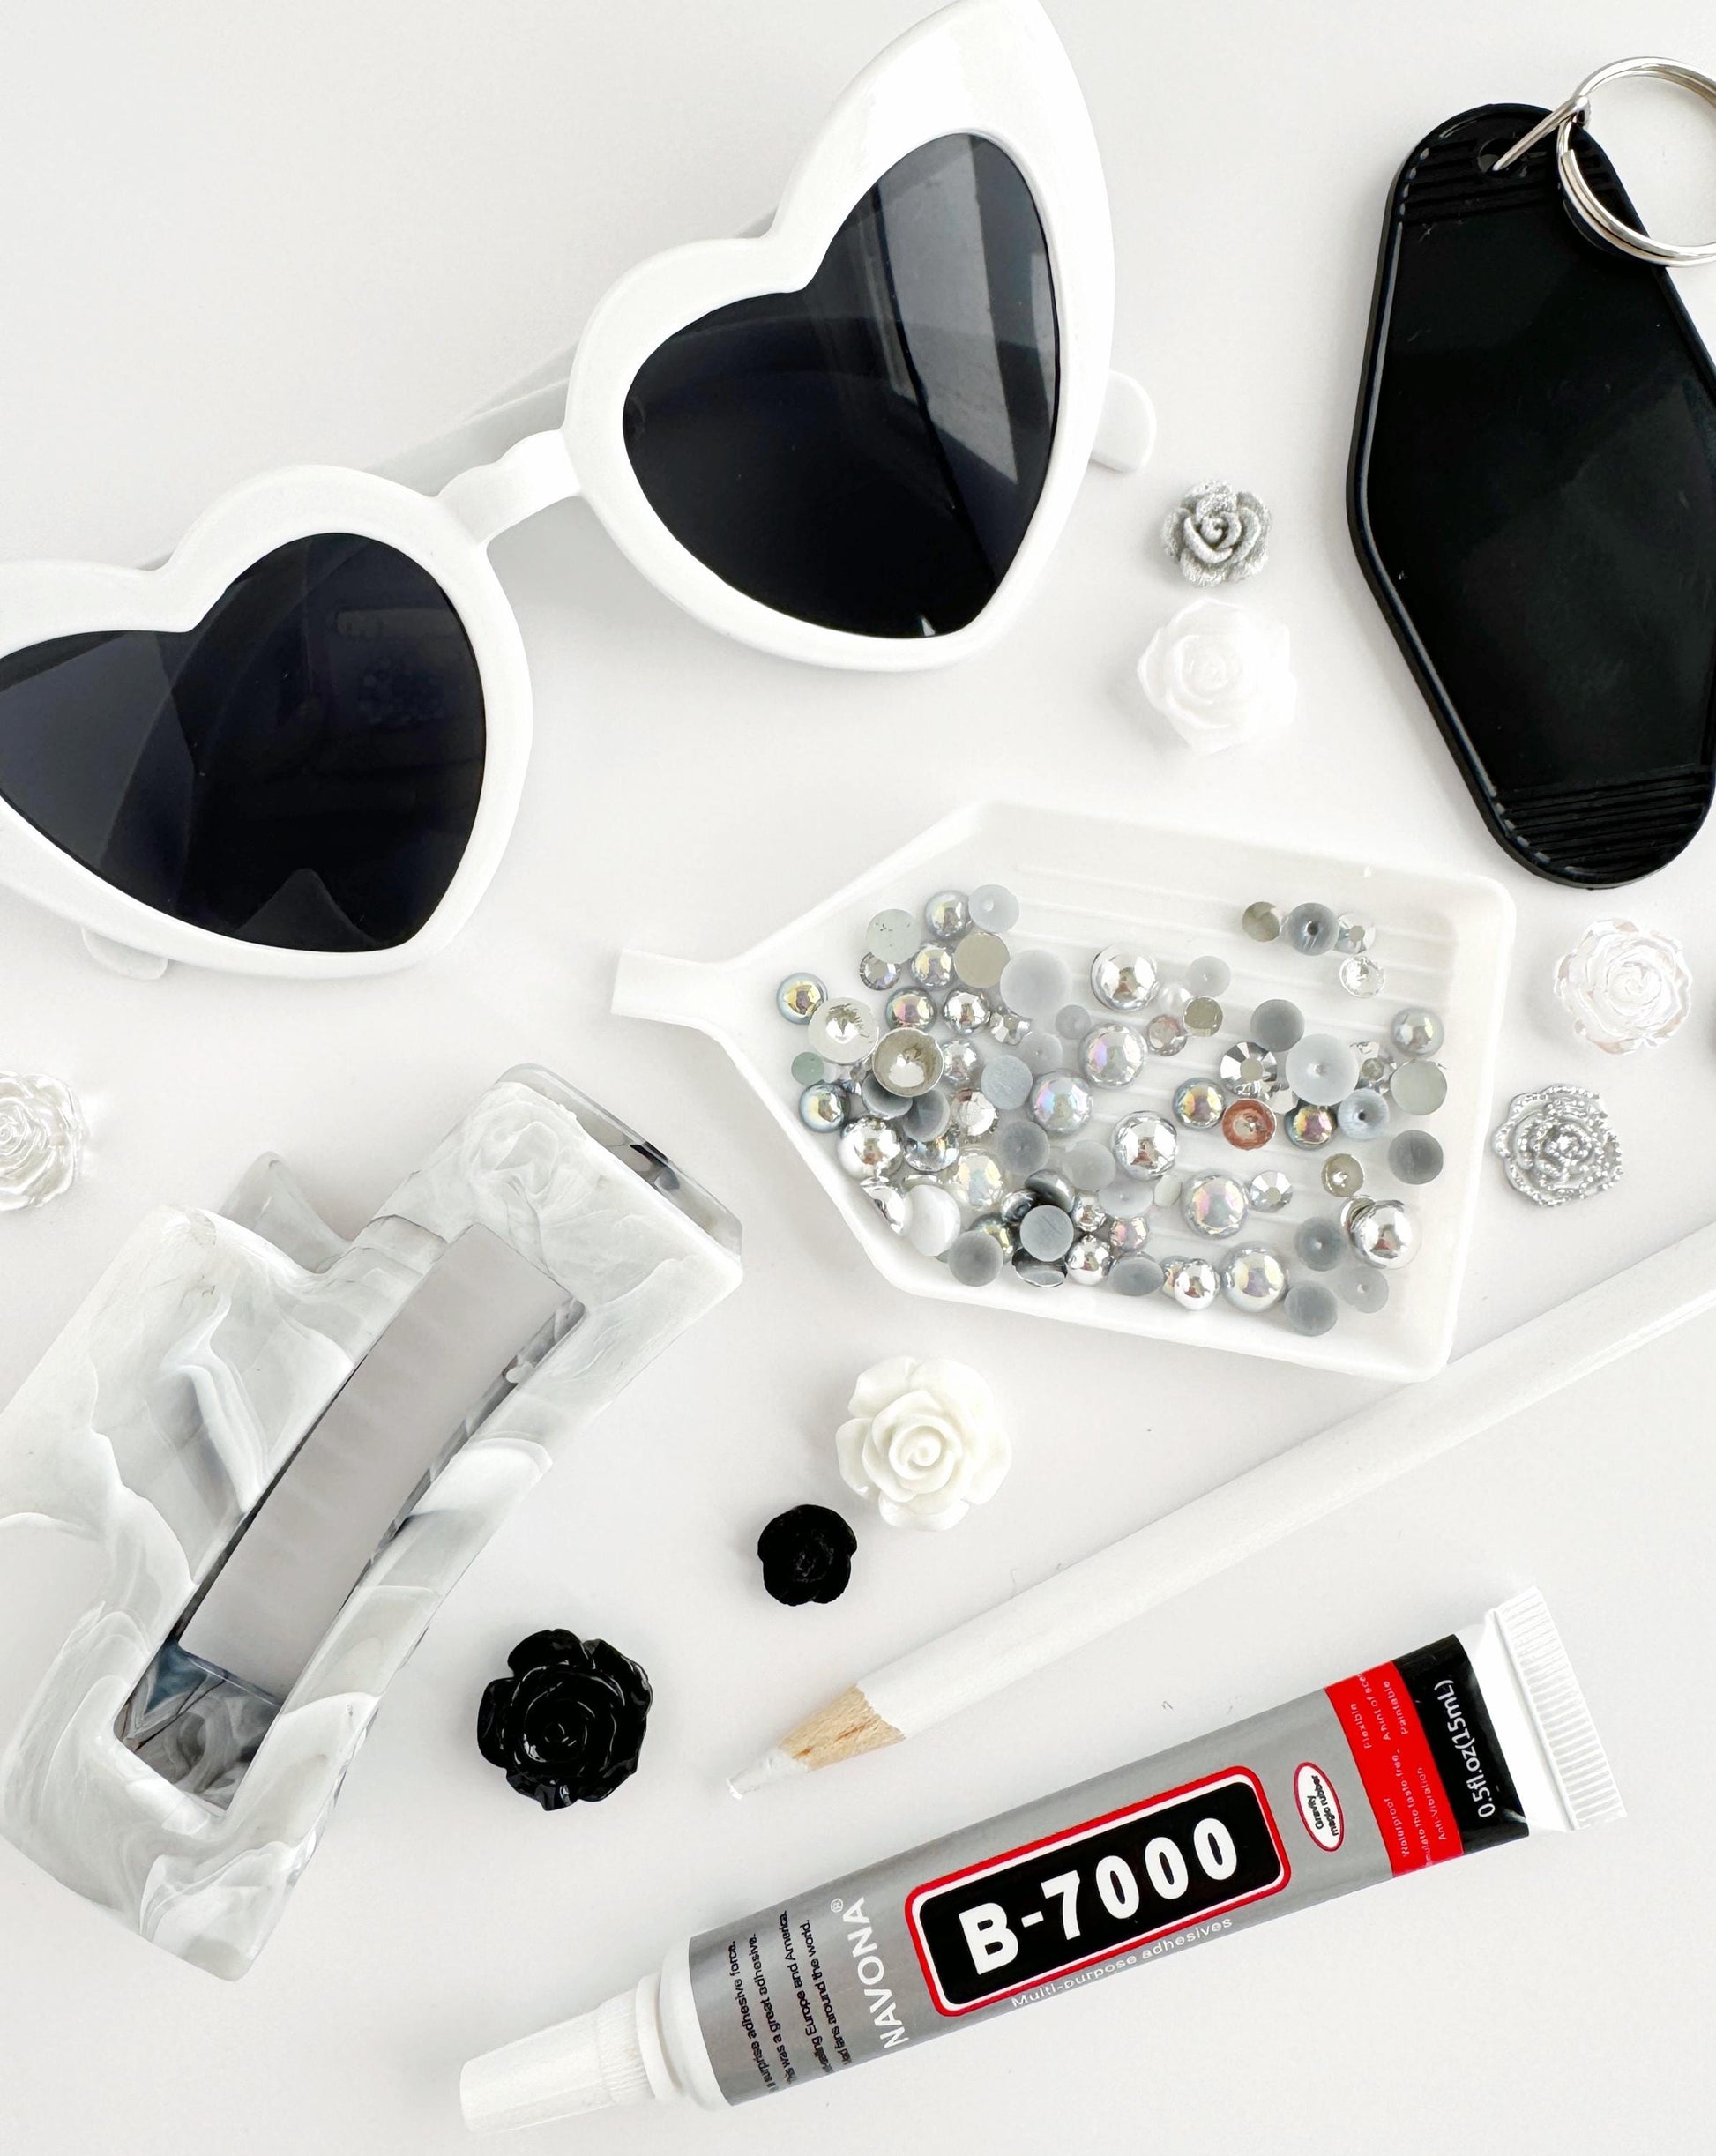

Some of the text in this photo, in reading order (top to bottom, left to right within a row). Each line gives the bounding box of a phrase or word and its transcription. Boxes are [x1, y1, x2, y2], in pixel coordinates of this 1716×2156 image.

[1366, 1696, 1377, 1707] of
[1373, 1708, 1387, 1731] hint
[1383, 1680, 1408, 1734] Paintable
[1350, 1703, 1372, 1749] Flexible
[1382, 1731, 1391, 1740] A
[1433, 1679, 1496, 1817] 0.5fl.oz(15mL)
[1306, 1794, 1324, 1830] Gravity
[1310, 1774, 1340, 1836] magic rubber
[1400, 1779, 1414, 1808] taste
[1416, 1766, 1446, 1840] Anti-Vibration
[1383, 1797, 1410, 1856] Waterproof
[1411, 1809, 1421, 1827] the
[959, 1818, 1237, 1975] B-7000
[778, 1909, 796, 1961] America.
[799, 1919, 817, 1957] world.
[727, 1939, 740, 1976] force.
[748, 1932, 768, 1996] adhesive.
[786, 1962, 802, 1988] and
[810, 1958, 823, 1981] the
[1011, 1918, 1233, 2007] Multi-purpose adhesives
[733, 1978, 757, 2040] adhesive
[759, 1996, 781, 2033] great
[795, 1989, 817, 2036] Europe
[813, 1981, 837, 2025] around
[772, 2033, 782, 2043] a
[775, 2043, 790, 2068] was
[830, 2025, 845, 2049] fans
[750, 2040, 772, 2083] surprise
